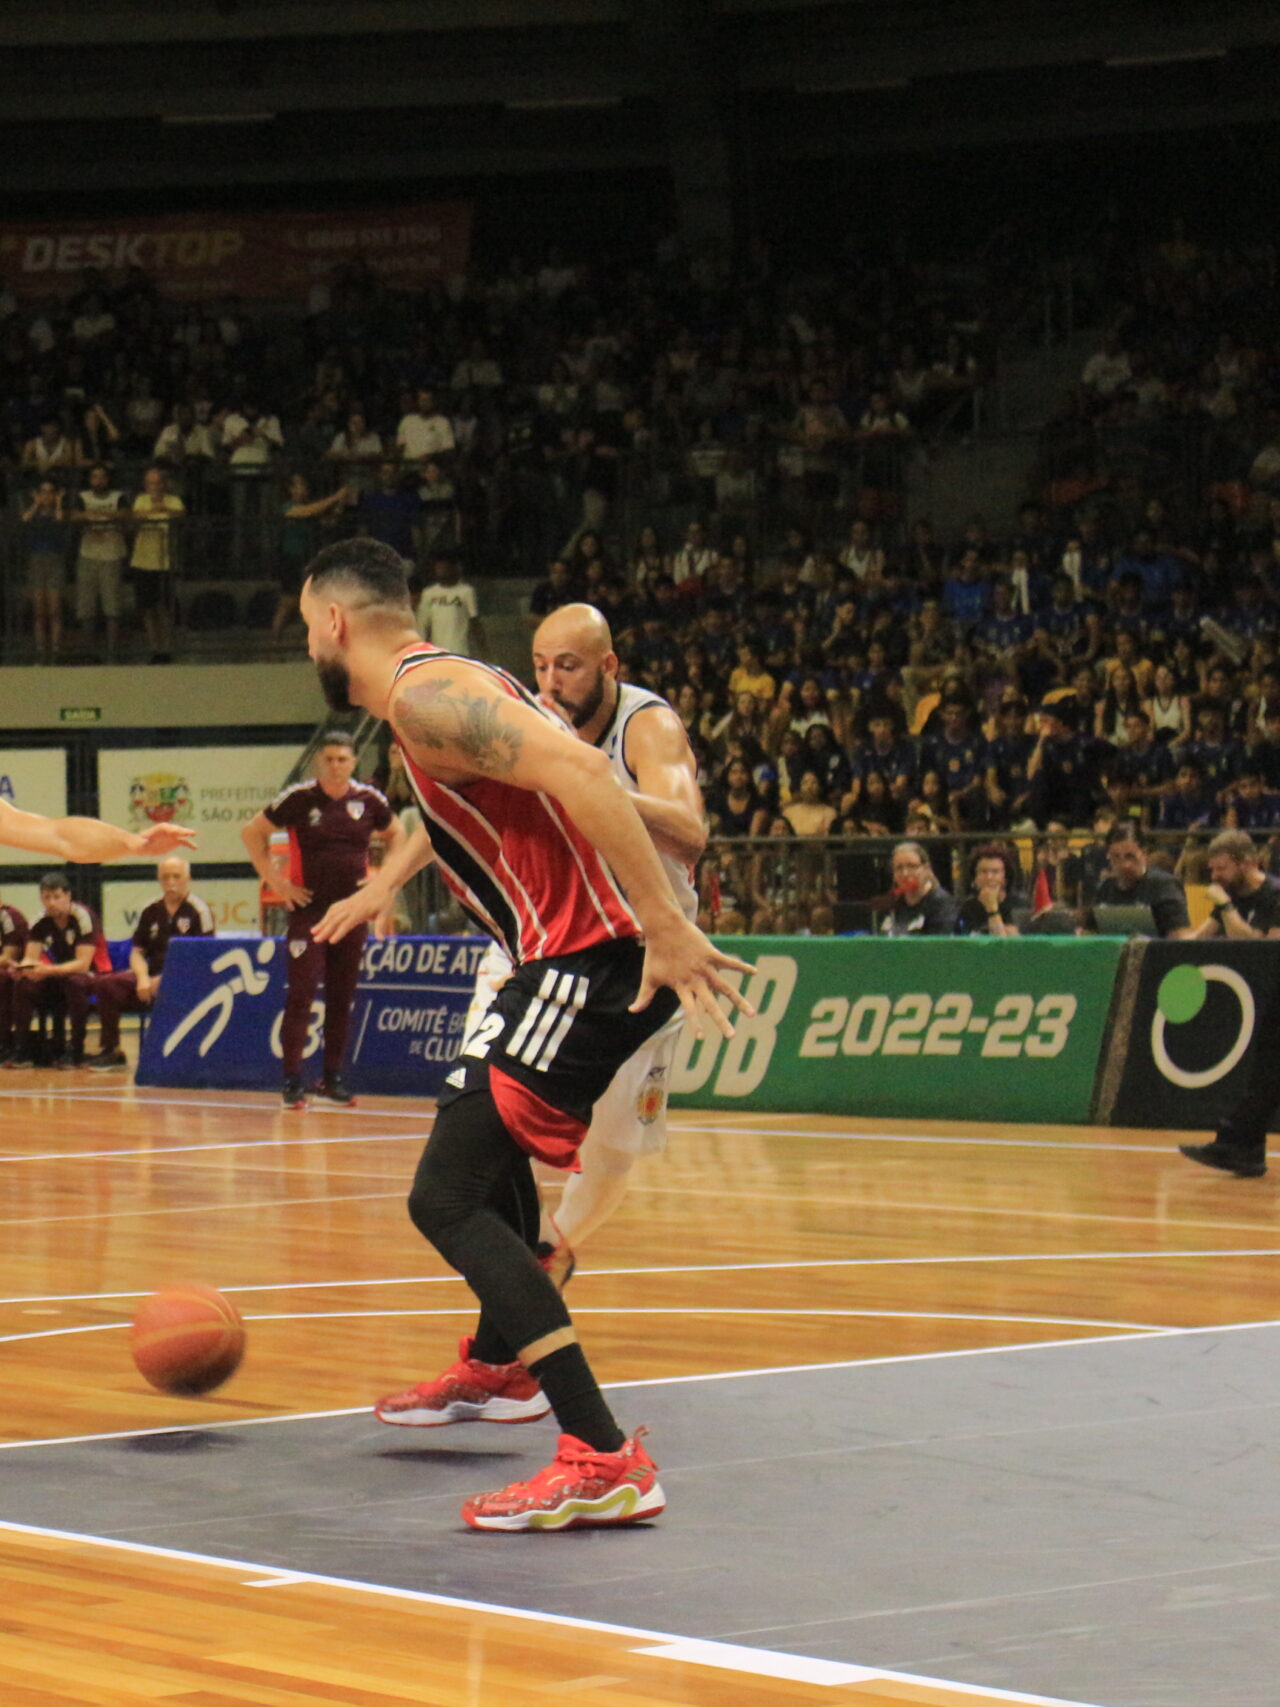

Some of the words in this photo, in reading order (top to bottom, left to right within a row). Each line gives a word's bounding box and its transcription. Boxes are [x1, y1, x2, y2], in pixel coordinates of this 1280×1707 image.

[22, 230, 244, 272] DESKTOP
[237, 808, 260, 822] JO
[416, 944, 450, 972] DE
[449, 944, 485, 976] AT
[377, 1005, 448, 1033] COMITÊ
[448, 1012, 467, 1032] BR
[799, 993, 1078, 1058] 2022-23
[424, 1036, 462, 1062] CLU
